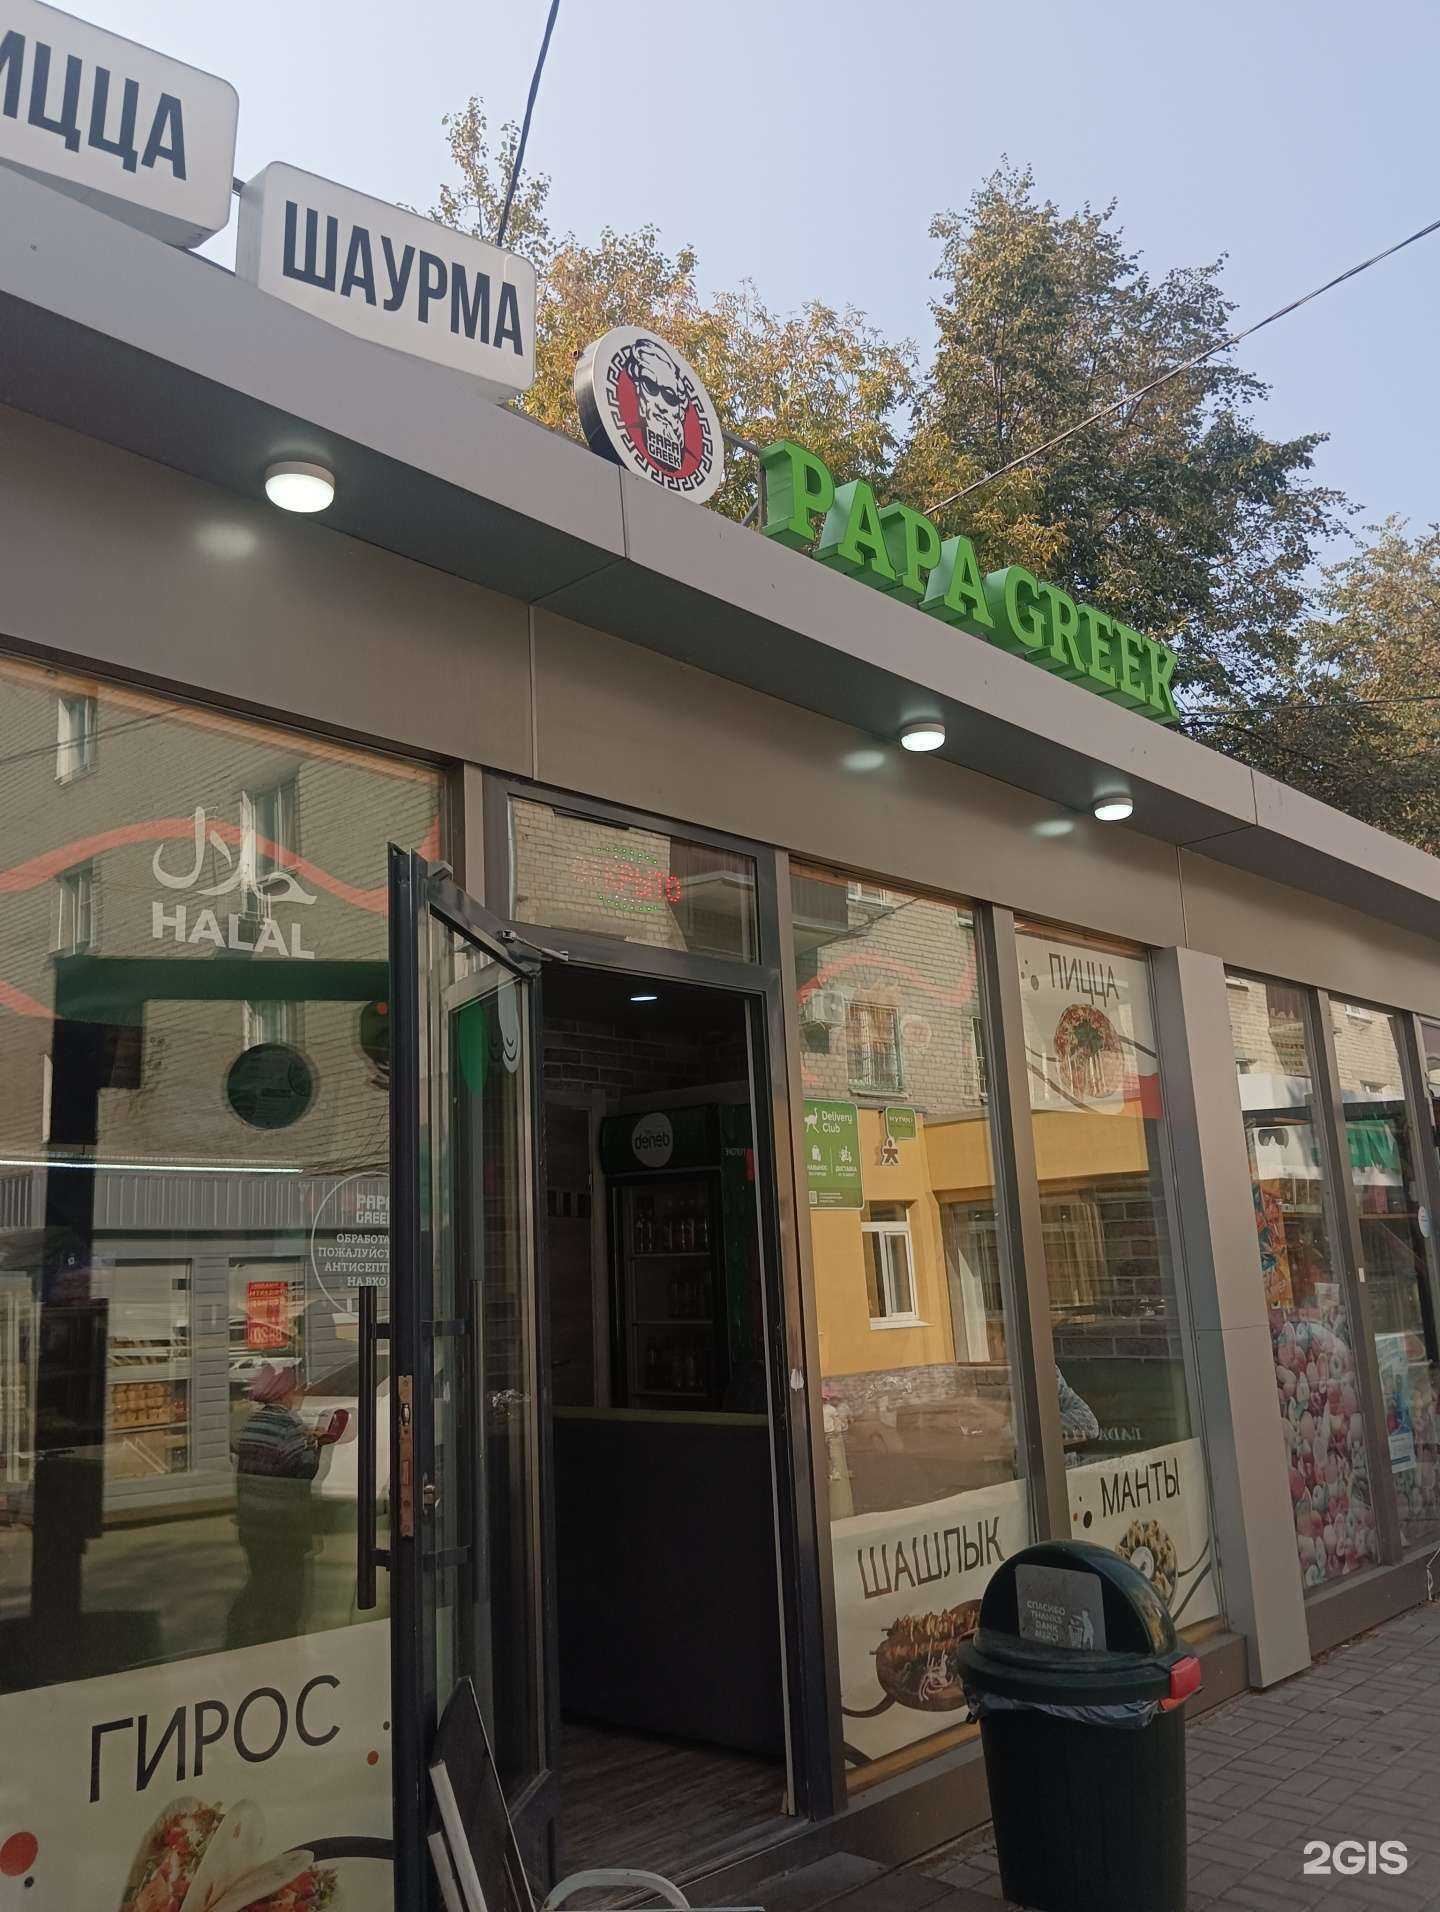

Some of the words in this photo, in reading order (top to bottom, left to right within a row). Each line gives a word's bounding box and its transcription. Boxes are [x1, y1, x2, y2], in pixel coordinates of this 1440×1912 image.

[282, 200, 524, 357] ШАУРМА
[647, 429, 680, 456] PAPA
[649, 443, 681, 468] GREEK
[766, 439, 996, 629] PAPA
[1001, 564, 1181, 720] GREEK
[152, 901, 316, 960] HALAL
[1048, 952, 1120, 1008] ПИЦЦА
[821, 1110, 853, 1125] Delivery
[822, 1122, 841, 1133] Club
[634, 1132, 671, 1150] deneb
[356, 1211, 389, 1224] GREE
[324, 1262, 390, 1273] АНТИСЕПТ
[365, 1277, 390, 1288] ВХО
[1099, 1457, 1181, 1517] МАНТЫ
[857, 1516, 1006, 1599] ШАШЛЫК
[89, 1674, 342, 1803] ГИРОС
